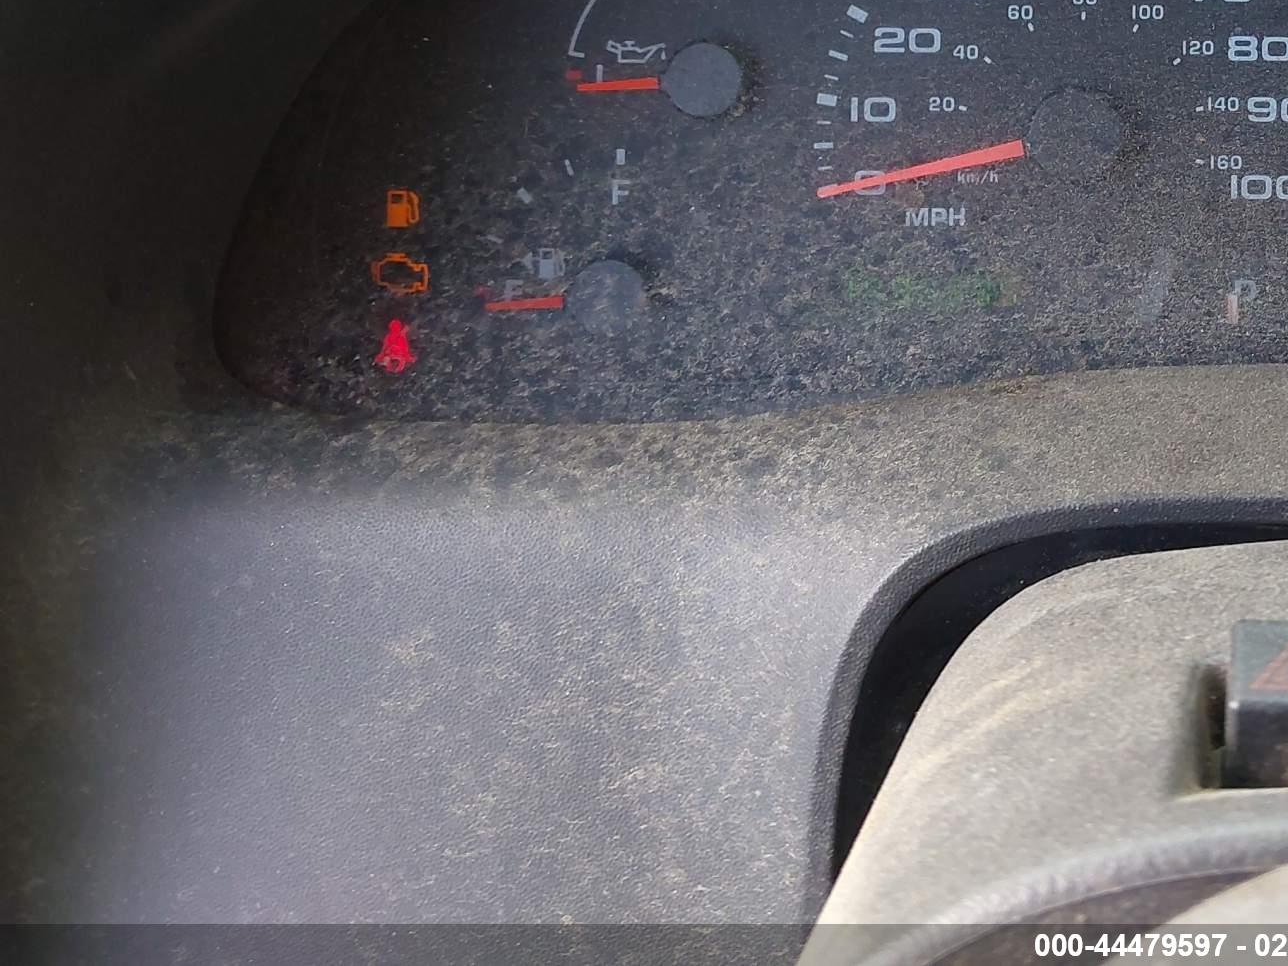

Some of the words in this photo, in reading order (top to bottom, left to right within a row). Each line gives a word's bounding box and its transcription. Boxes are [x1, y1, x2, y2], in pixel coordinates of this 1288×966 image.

[1007, 5, 1033, 21] 60
[1130, 5, 1164, 21] 100
[873, 27, 941, 53] 20
[1181, 40, 1214, 56] 120
[952, 44, 979, 60] 40
[849, 96, 896, 123] 10
[928, 97, 955, 113] 20
[1206, 97, 1240, 113] 140
[1209, 155, 1243, 170] 160
[854, 170, 886, 195] 0
[612, 179, 631, 205] F
[905, 207, 967, 227] MPH
